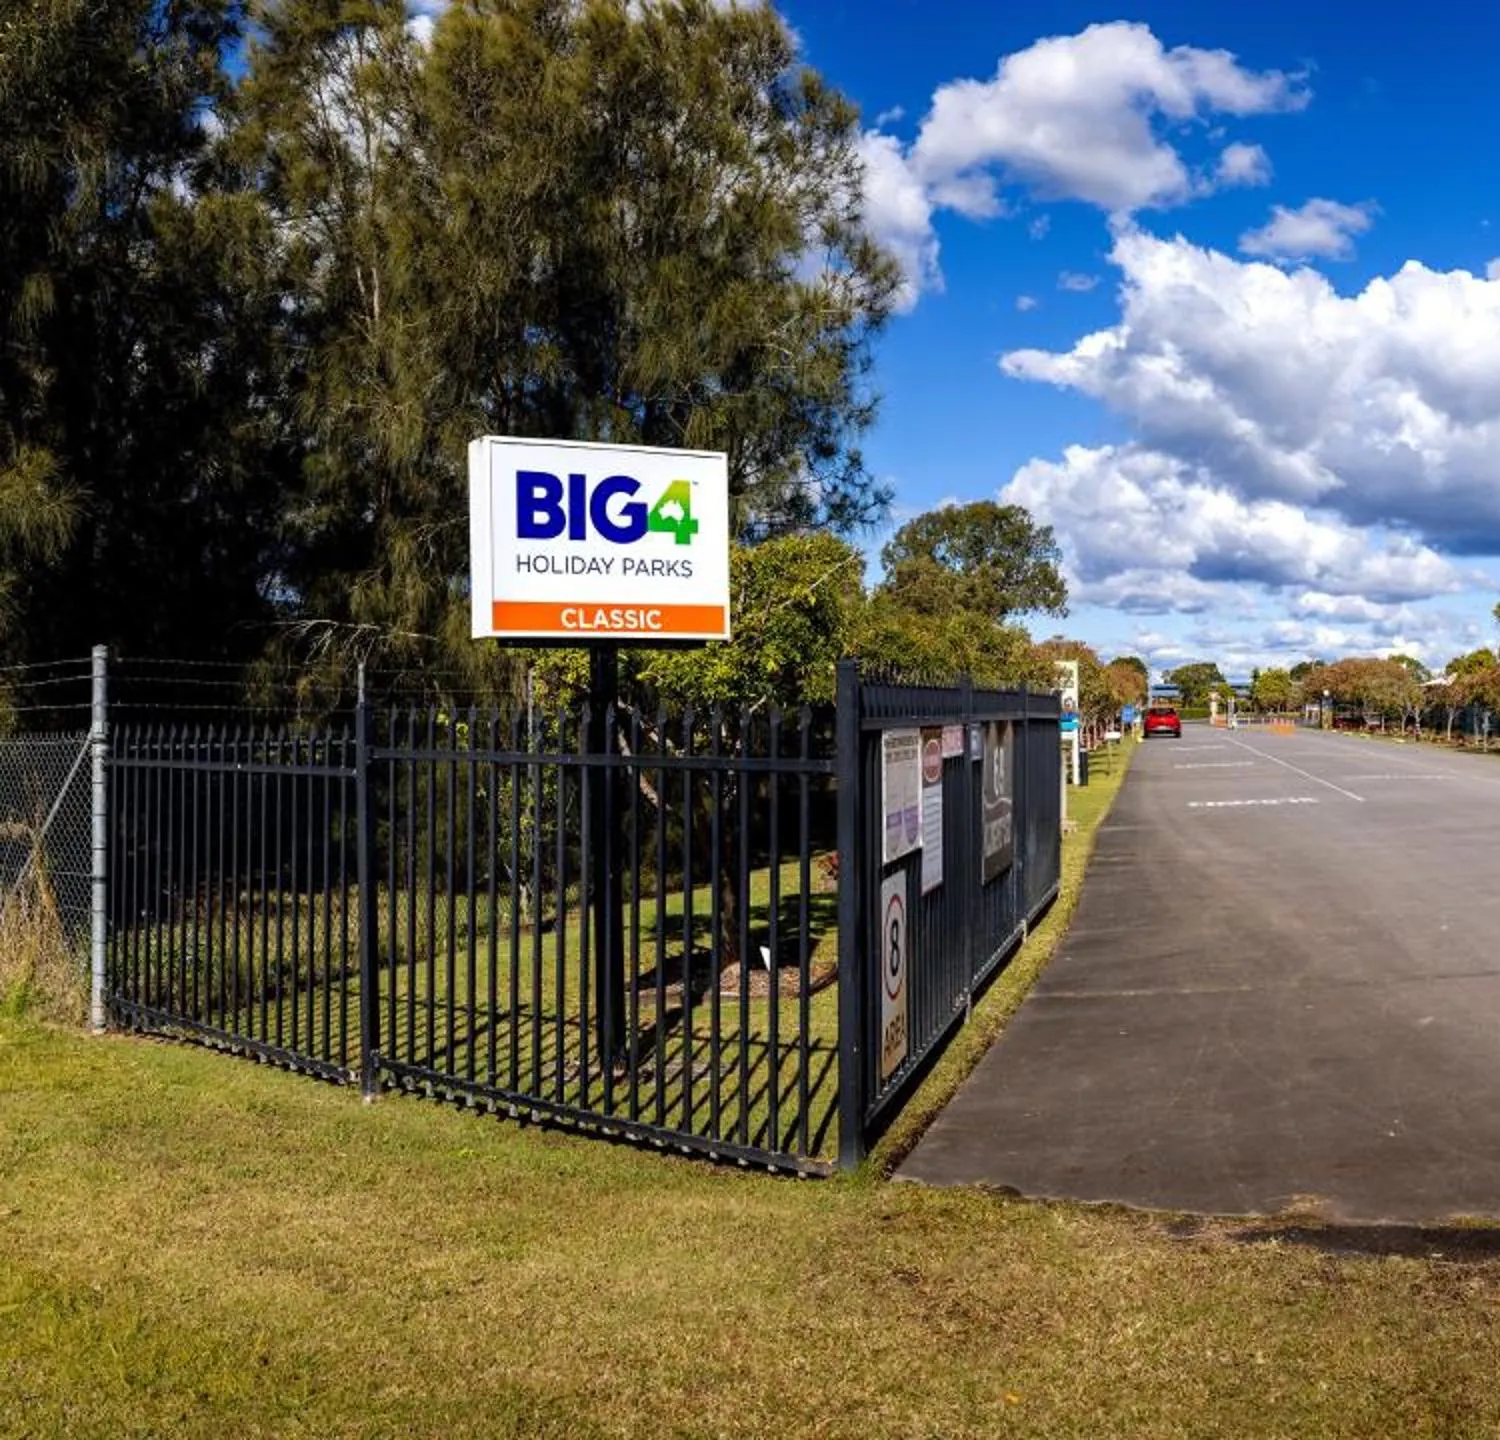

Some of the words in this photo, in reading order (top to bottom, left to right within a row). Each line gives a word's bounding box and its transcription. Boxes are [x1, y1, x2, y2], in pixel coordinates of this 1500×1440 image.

[516, 470, 698, 545] BIG4
[516, 554, 614, 576] HOLIDAY
[623, 558, 693, 579] PARKS
[560, 608, 662, 630] CLASSIC
[890, 918, 900, 977] 8
